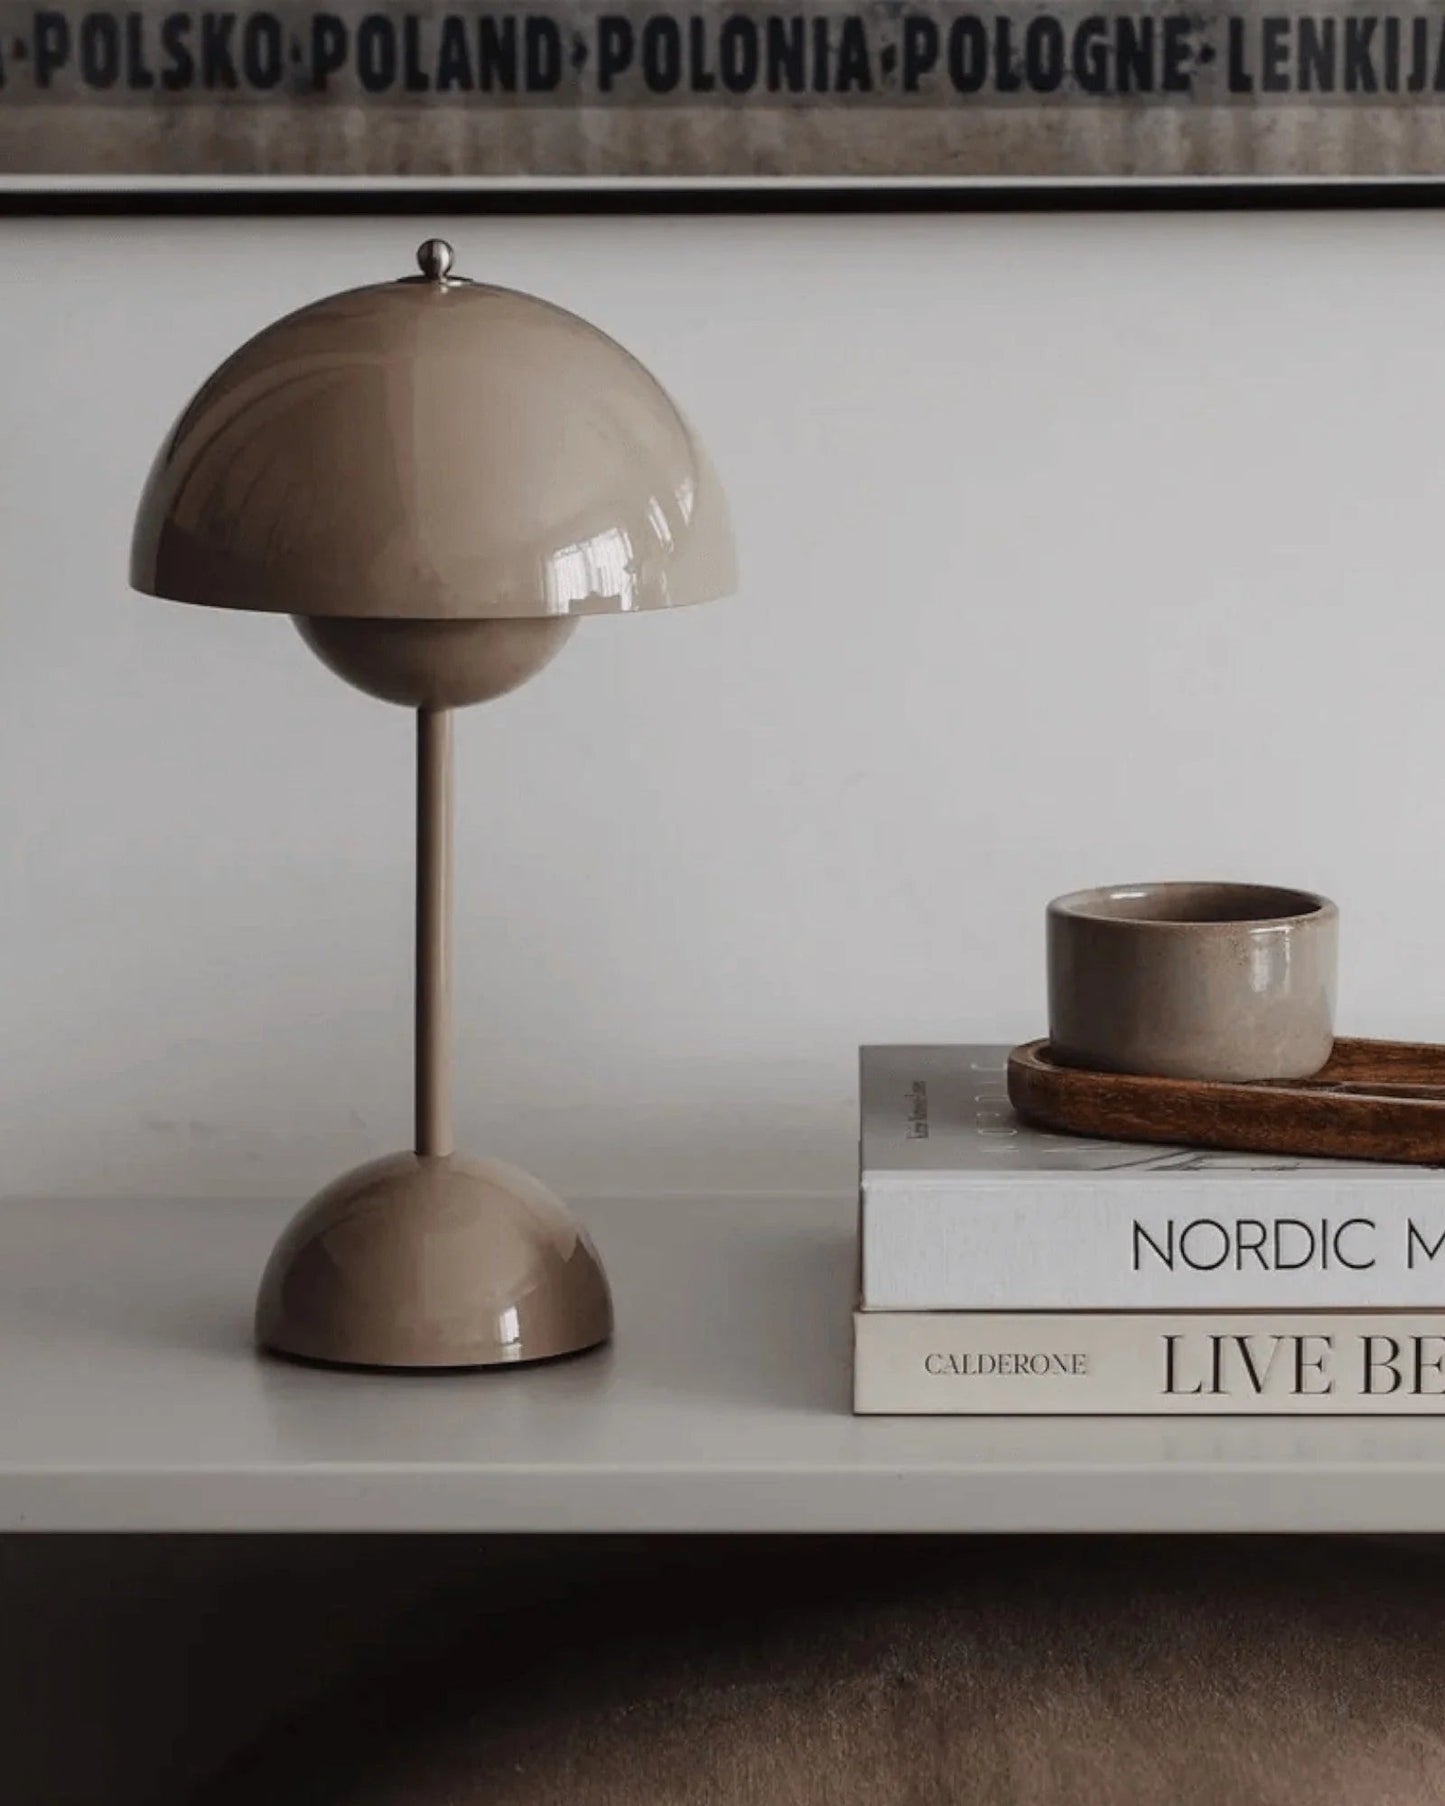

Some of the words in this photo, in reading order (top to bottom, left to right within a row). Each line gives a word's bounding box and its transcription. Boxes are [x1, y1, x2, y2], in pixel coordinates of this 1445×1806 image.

[33, 11, 283, 91] POLSKO
[311, 13, 562, 93] POLAND
[597, 14, 873, 93] POLONIA
[904, 15, 1192, 94] POLOGNE
[1132, 1217, 1377, 1271] NORDIC
[924, 1352, 1087, 1375] CALDERONE
[1161, 1334, 1334, 1395] LIVE
[1358, 1334, 1445, 1395] BE
